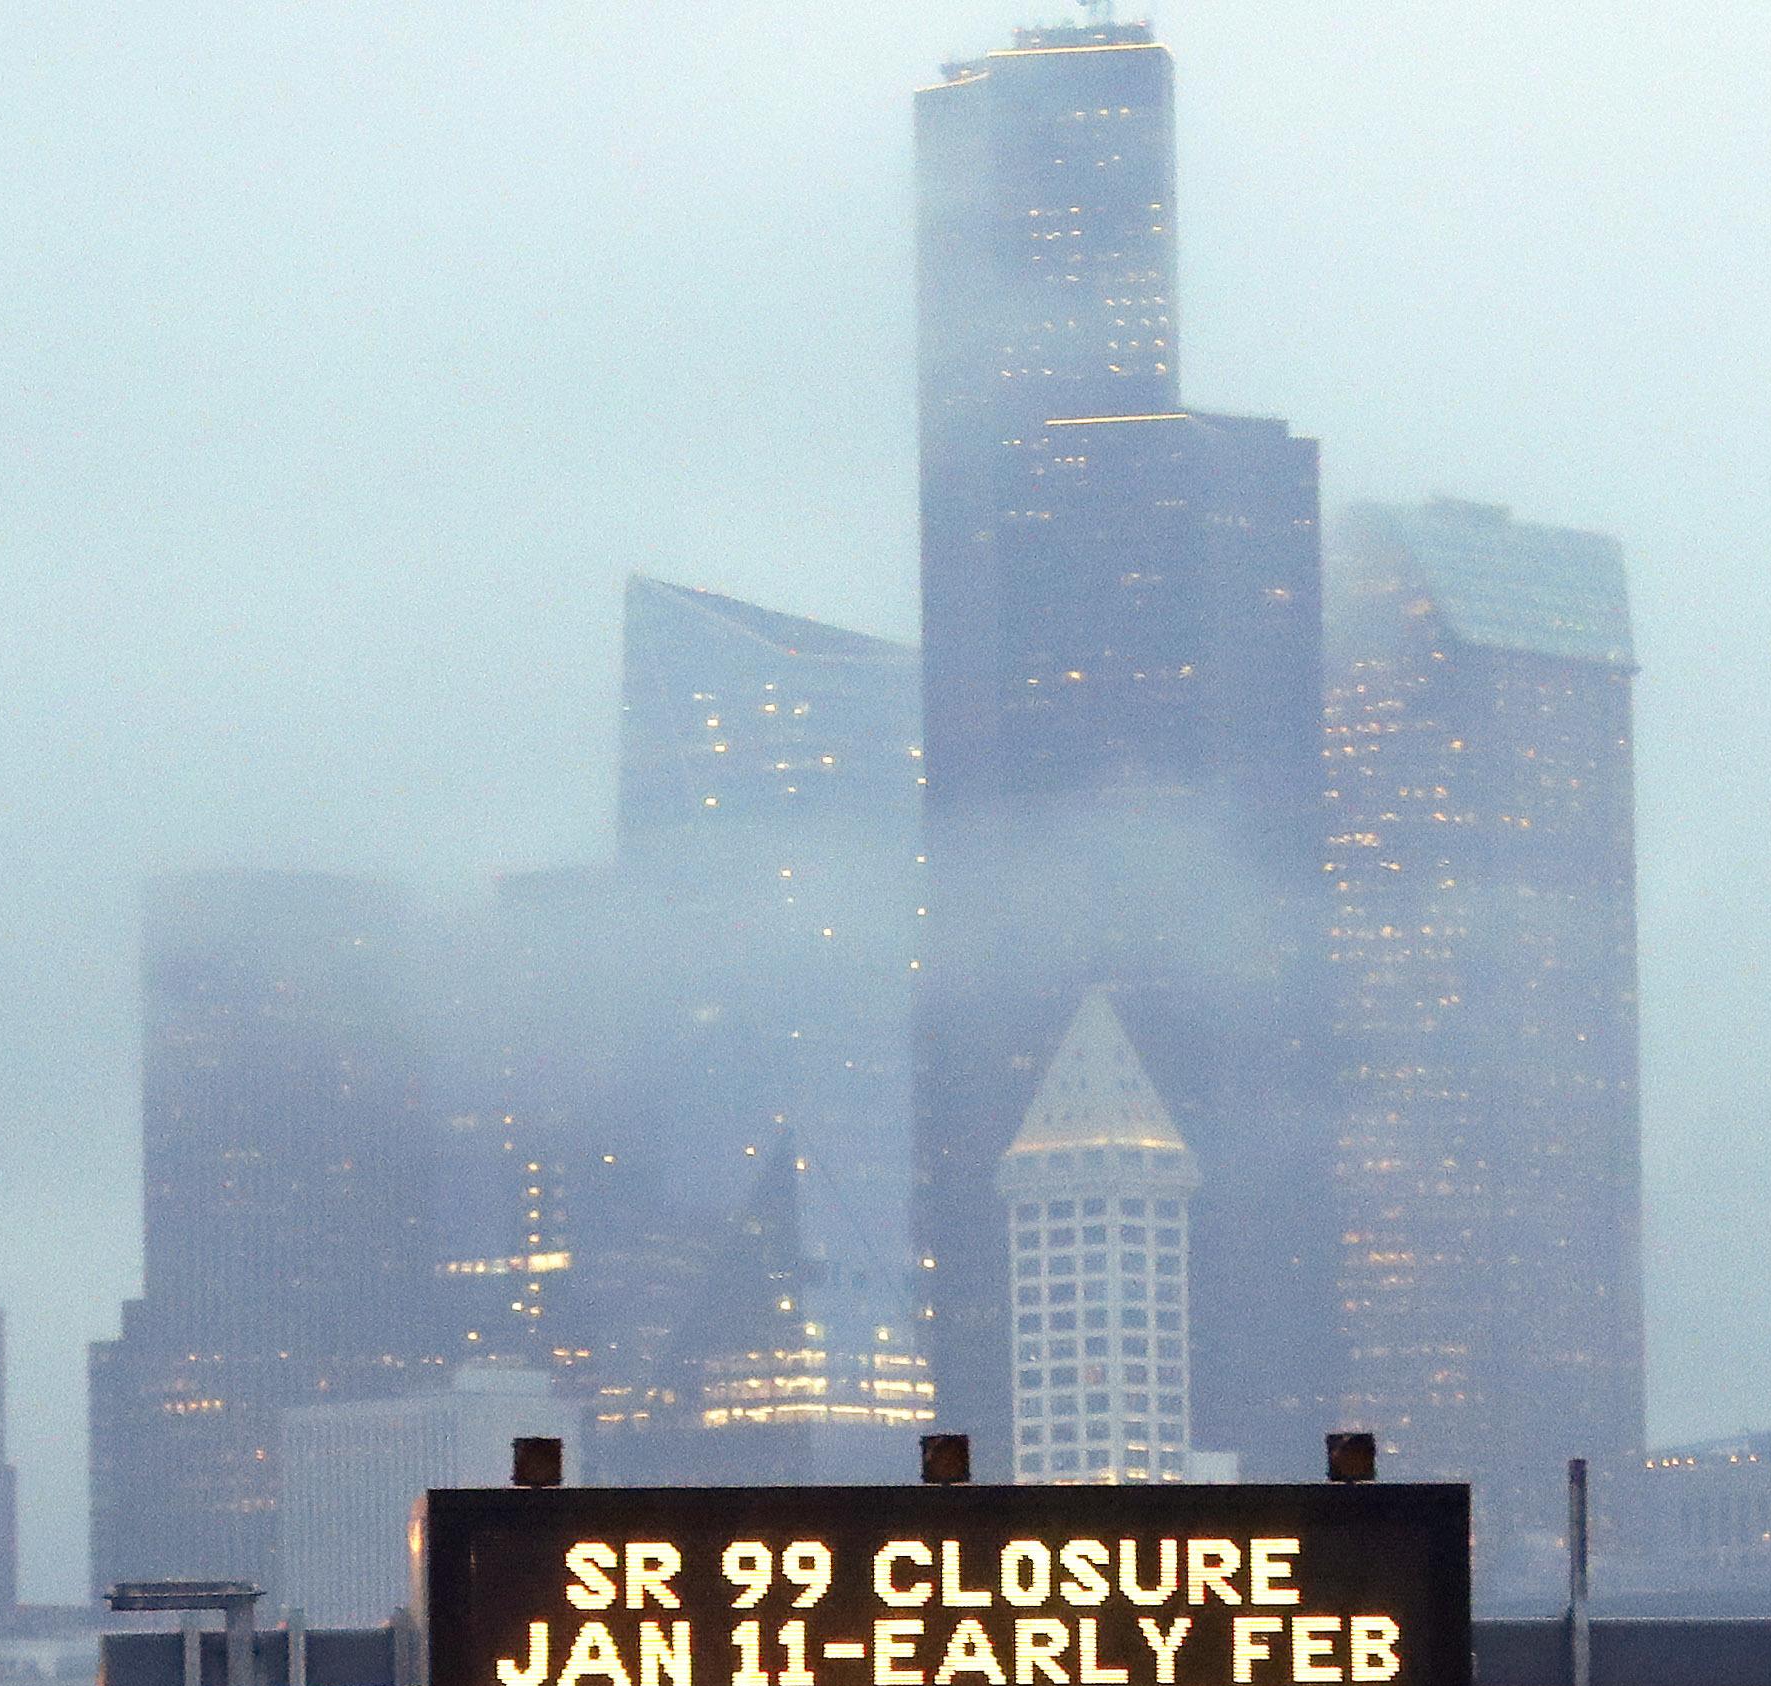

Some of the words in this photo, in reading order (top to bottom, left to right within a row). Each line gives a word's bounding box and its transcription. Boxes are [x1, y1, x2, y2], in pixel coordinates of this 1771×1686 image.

[564, 1540, 683, 1611] SR
[720, 1540, 833, 1610] 99
[870, 1537, 1302, 1608] CLOSURE
[1231, 1614, 1402, 1685] FEB
